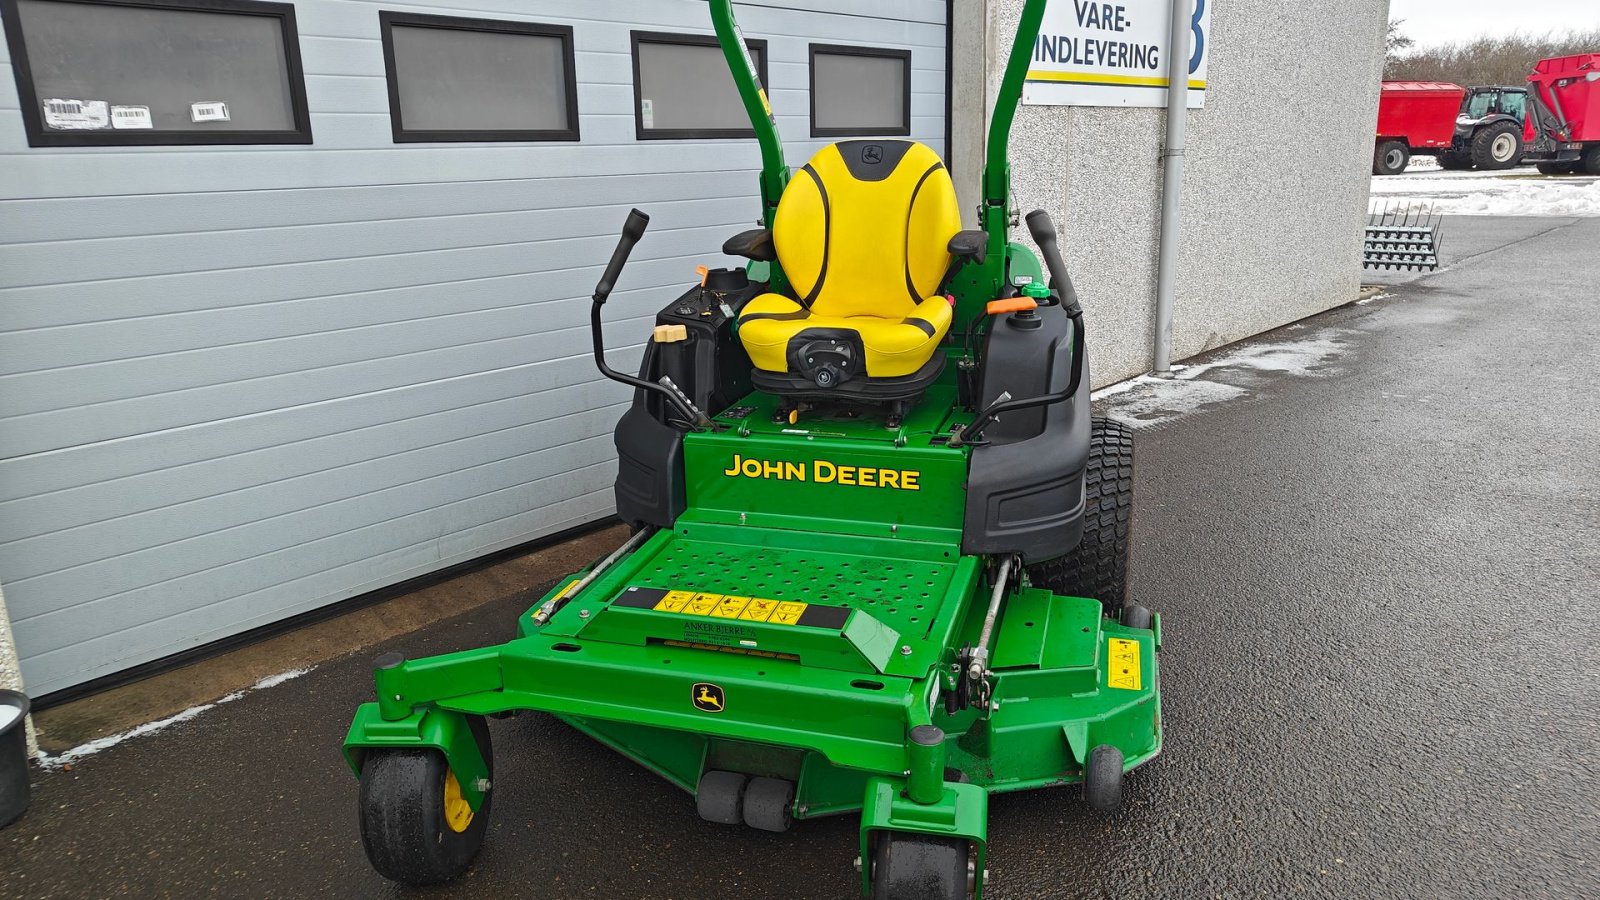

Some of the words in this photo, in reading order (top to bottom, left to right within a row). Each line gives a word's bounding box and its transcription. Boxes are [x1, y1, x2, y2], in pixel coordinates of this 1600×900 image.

[1073, 0, 1131, 32] VARE-
[1035, 34, 1159, 70] INDLEVERING
[724, 454, 807, 482] JOHN
[813, 458, 921, 491] DEERE
[684, 622, 715, 632] ANKER
[716, 624, 745, 634] BJERRE
